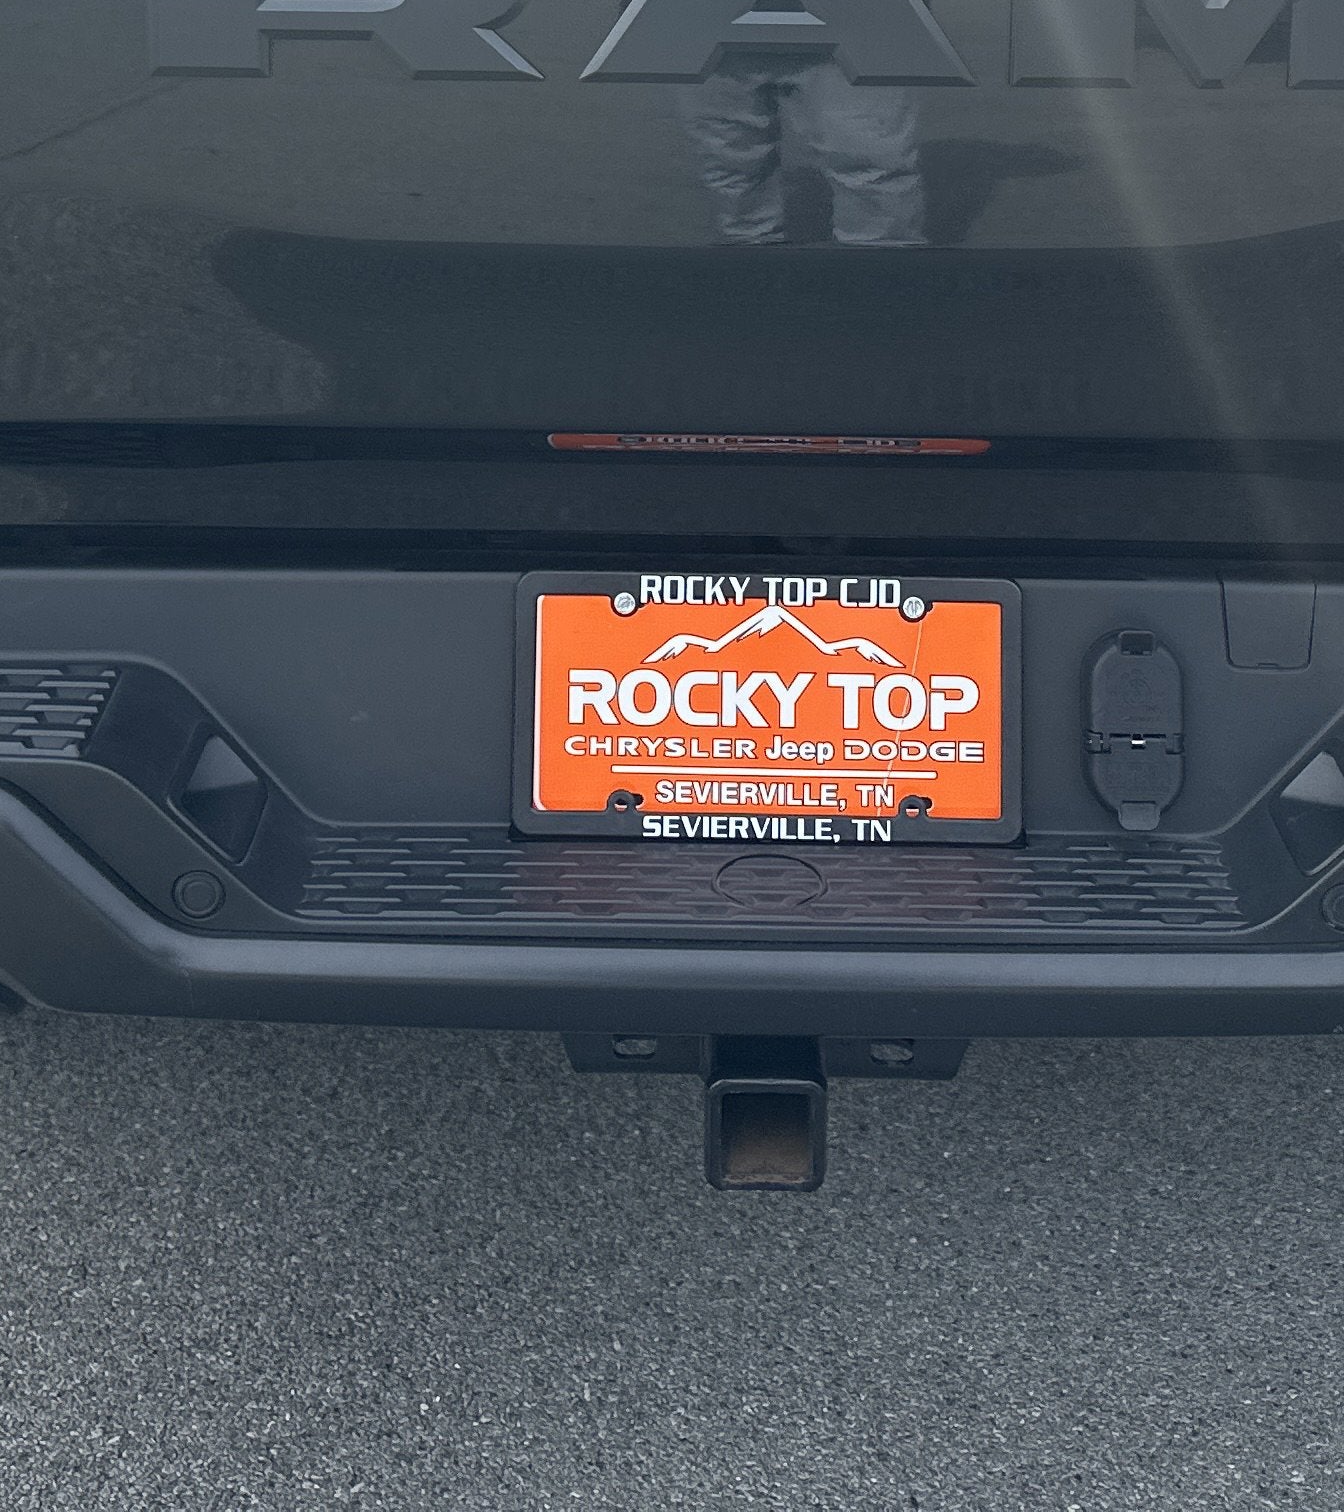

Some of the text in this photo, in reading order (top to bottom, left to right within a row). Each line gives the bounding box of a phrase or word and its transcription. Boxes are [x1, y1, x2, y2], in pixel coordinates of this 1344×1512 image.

[640, 574, 901, 610] ROCKY TOP CJD
[567, 668, 980, 732] ROCKY TOP
[565, 735, 985, 764] CHRYSLER Jeep DODGE
[655, 780, 894, 811] SEVIERVILLE, TN
[642, 816, 892, 843] SEVIERVILLE, TN
